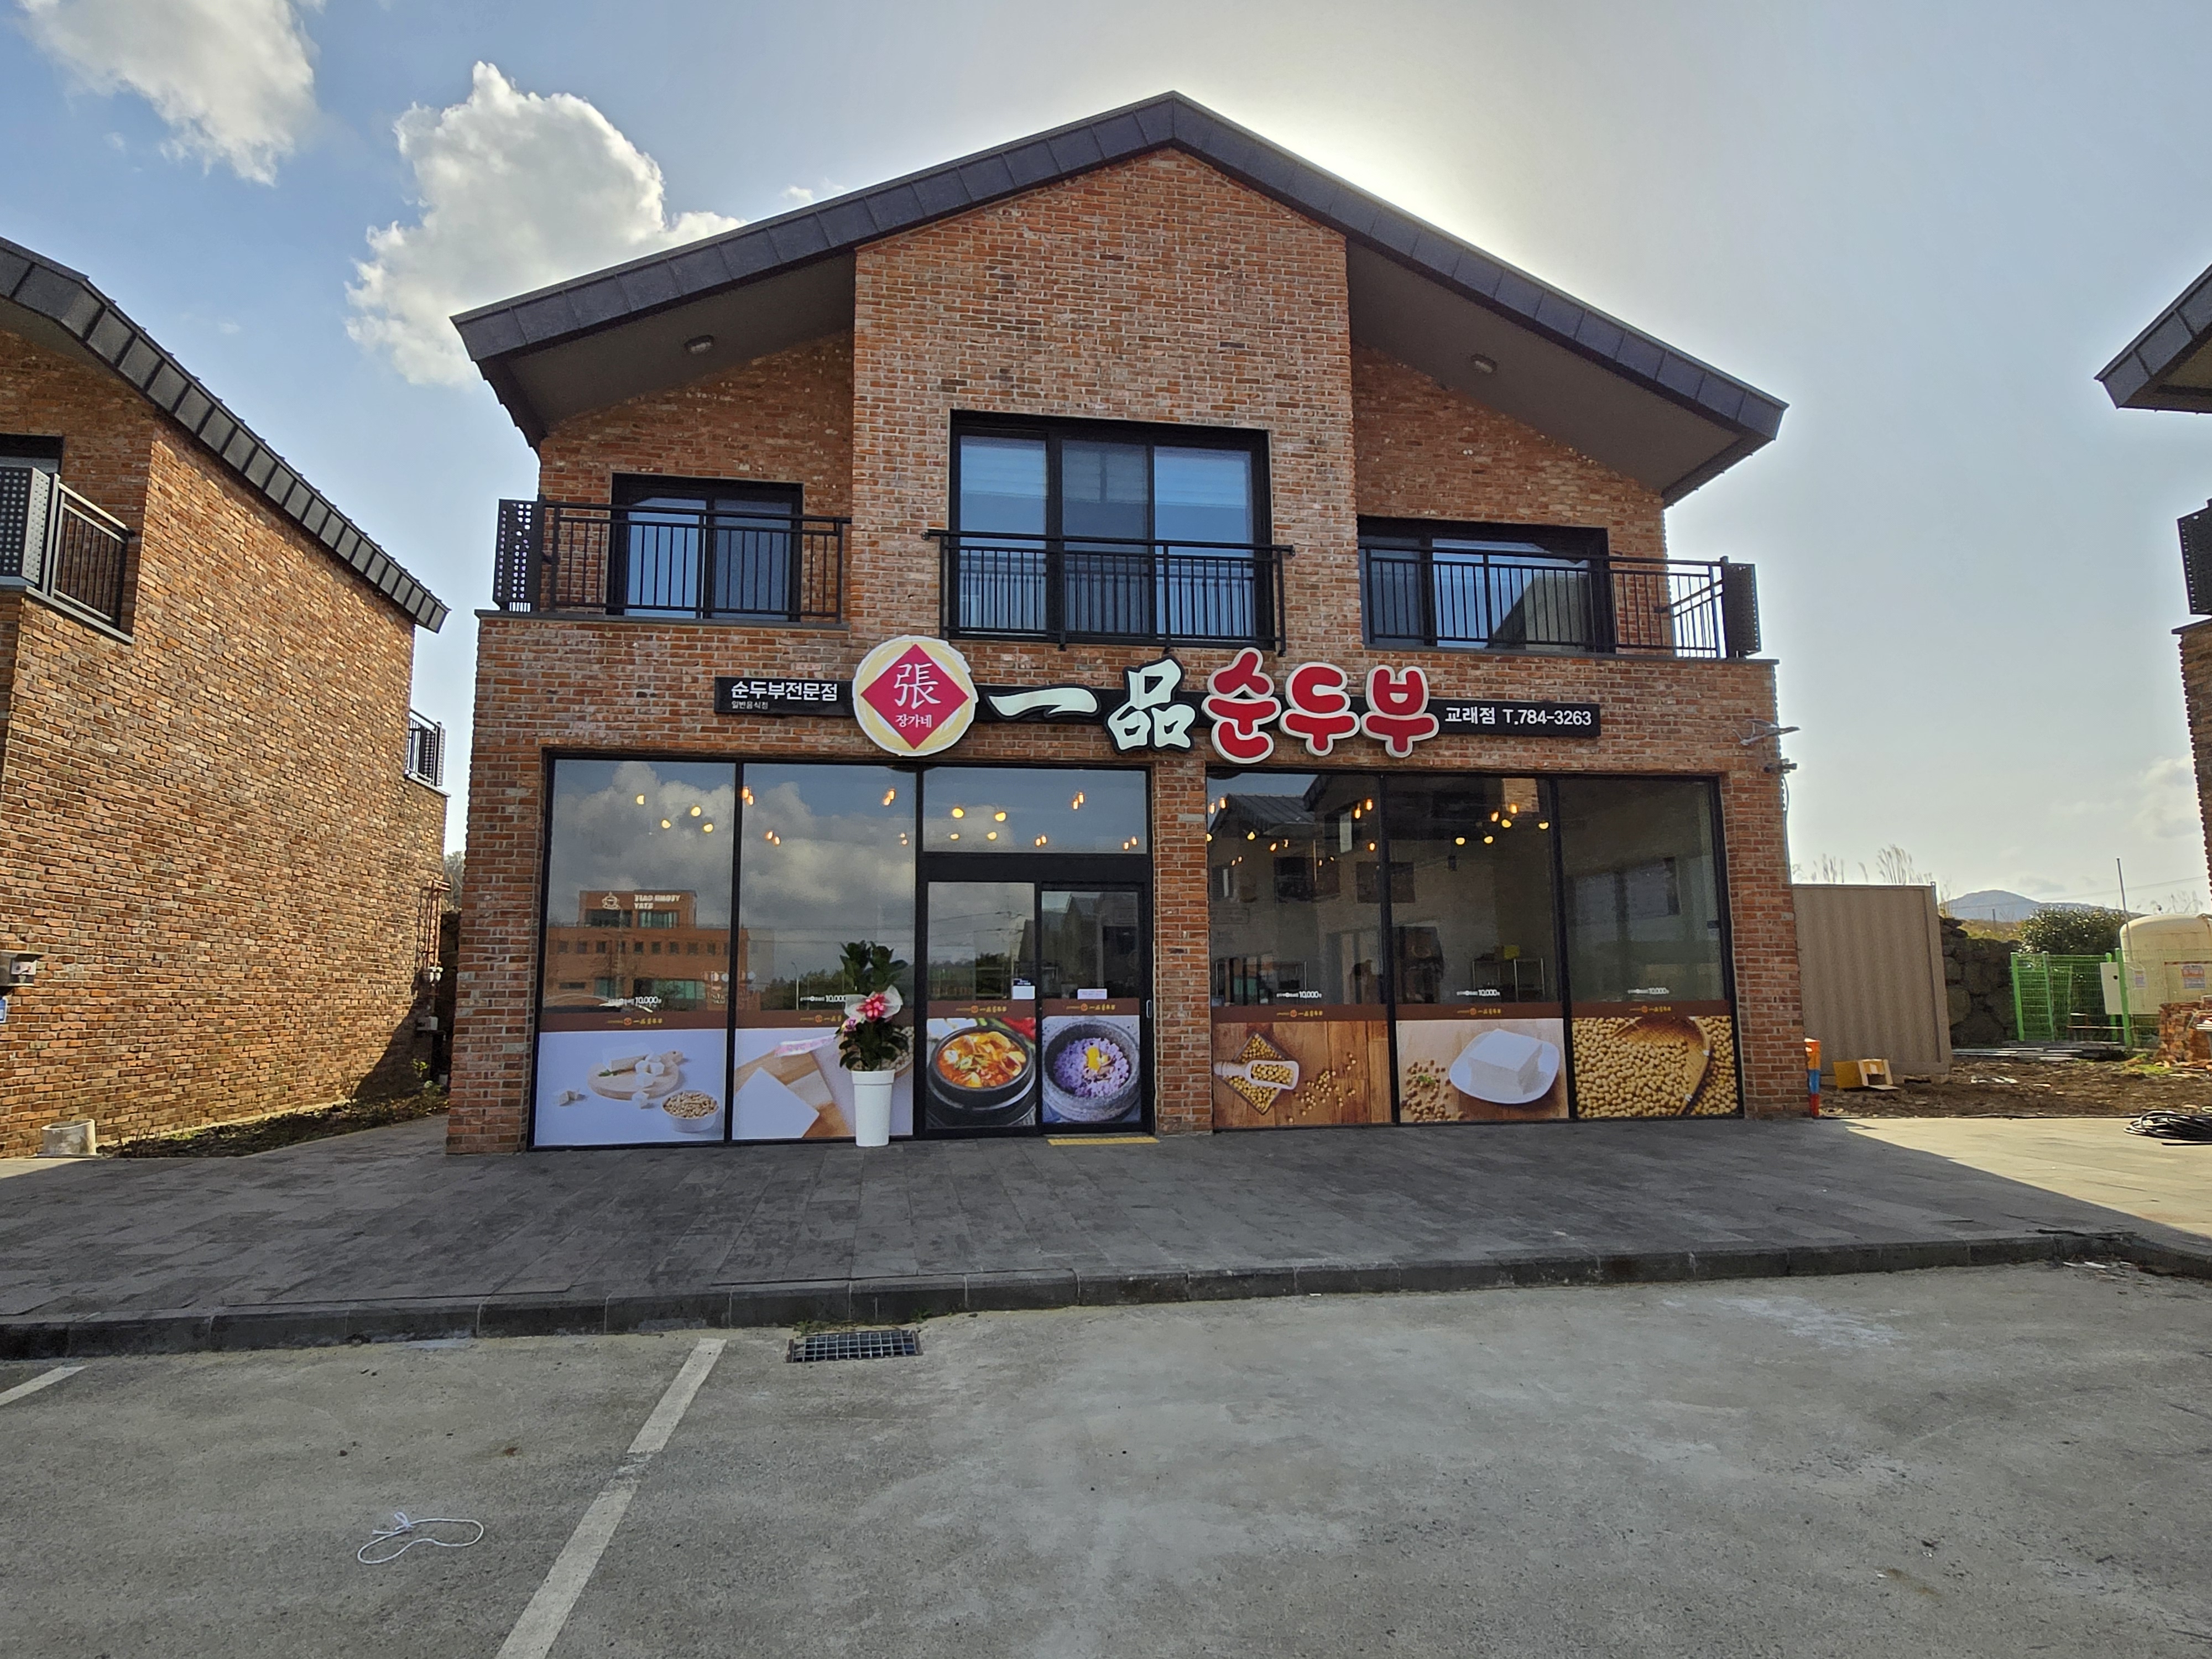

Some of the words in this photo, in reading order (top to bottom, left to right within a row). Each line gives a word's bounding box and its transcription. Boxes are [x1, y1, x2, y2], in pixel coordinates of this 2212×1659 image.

[731, 680, 838, 702] 순두부전문점
[893, 662, 942, 709] 張
[731, 701, 769, 709] 일반음식점
[1202, 647, 1439, 764] 순두부
[894, 713, 932, 728] 장가네
[1444, 706, 1496, 725] 교래점
[1502, 708, 1592, 726] T.784-3263
